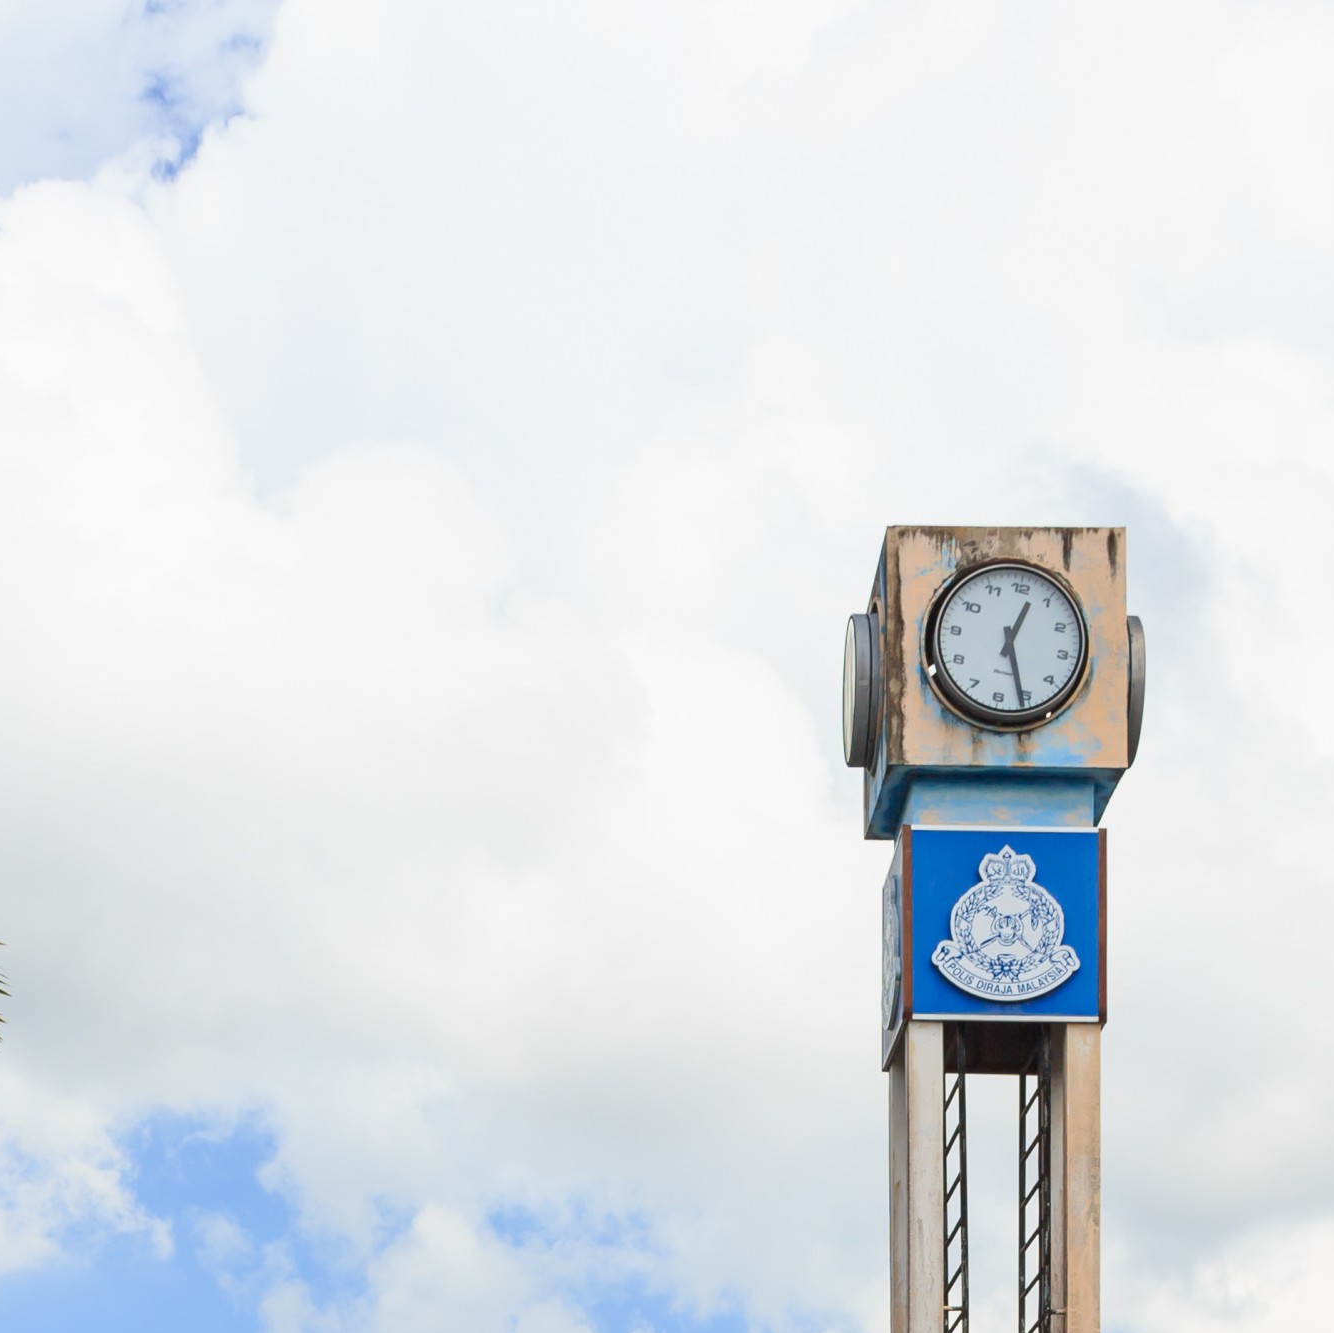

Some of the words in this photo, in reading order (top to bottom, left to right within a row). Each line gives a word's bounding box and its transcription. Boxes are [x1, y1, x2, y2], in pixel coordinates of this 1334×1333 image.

[985, 584, 1001, 597] 11
[1011, 582, 1031, 595] 12
[961, 601, 981, 614] 10
[1042, 597, 1051, 608] 1
[950, 625, 962, 636] 9
[1054, 622, 1066, 633] 2
[953, 654, 965, 665] 8
[1057, 650, 1069, 660] 3
[969, 678, 980, 688] 7
[1043, 675, 1055, 685] 4
[992, 692, 1004, 703] 6
[948, 962, 975, 985] POLIS
[976, 980, 1013, 995] DIRAJA
[1018, 966, 1064, 993] MALAYSIA
